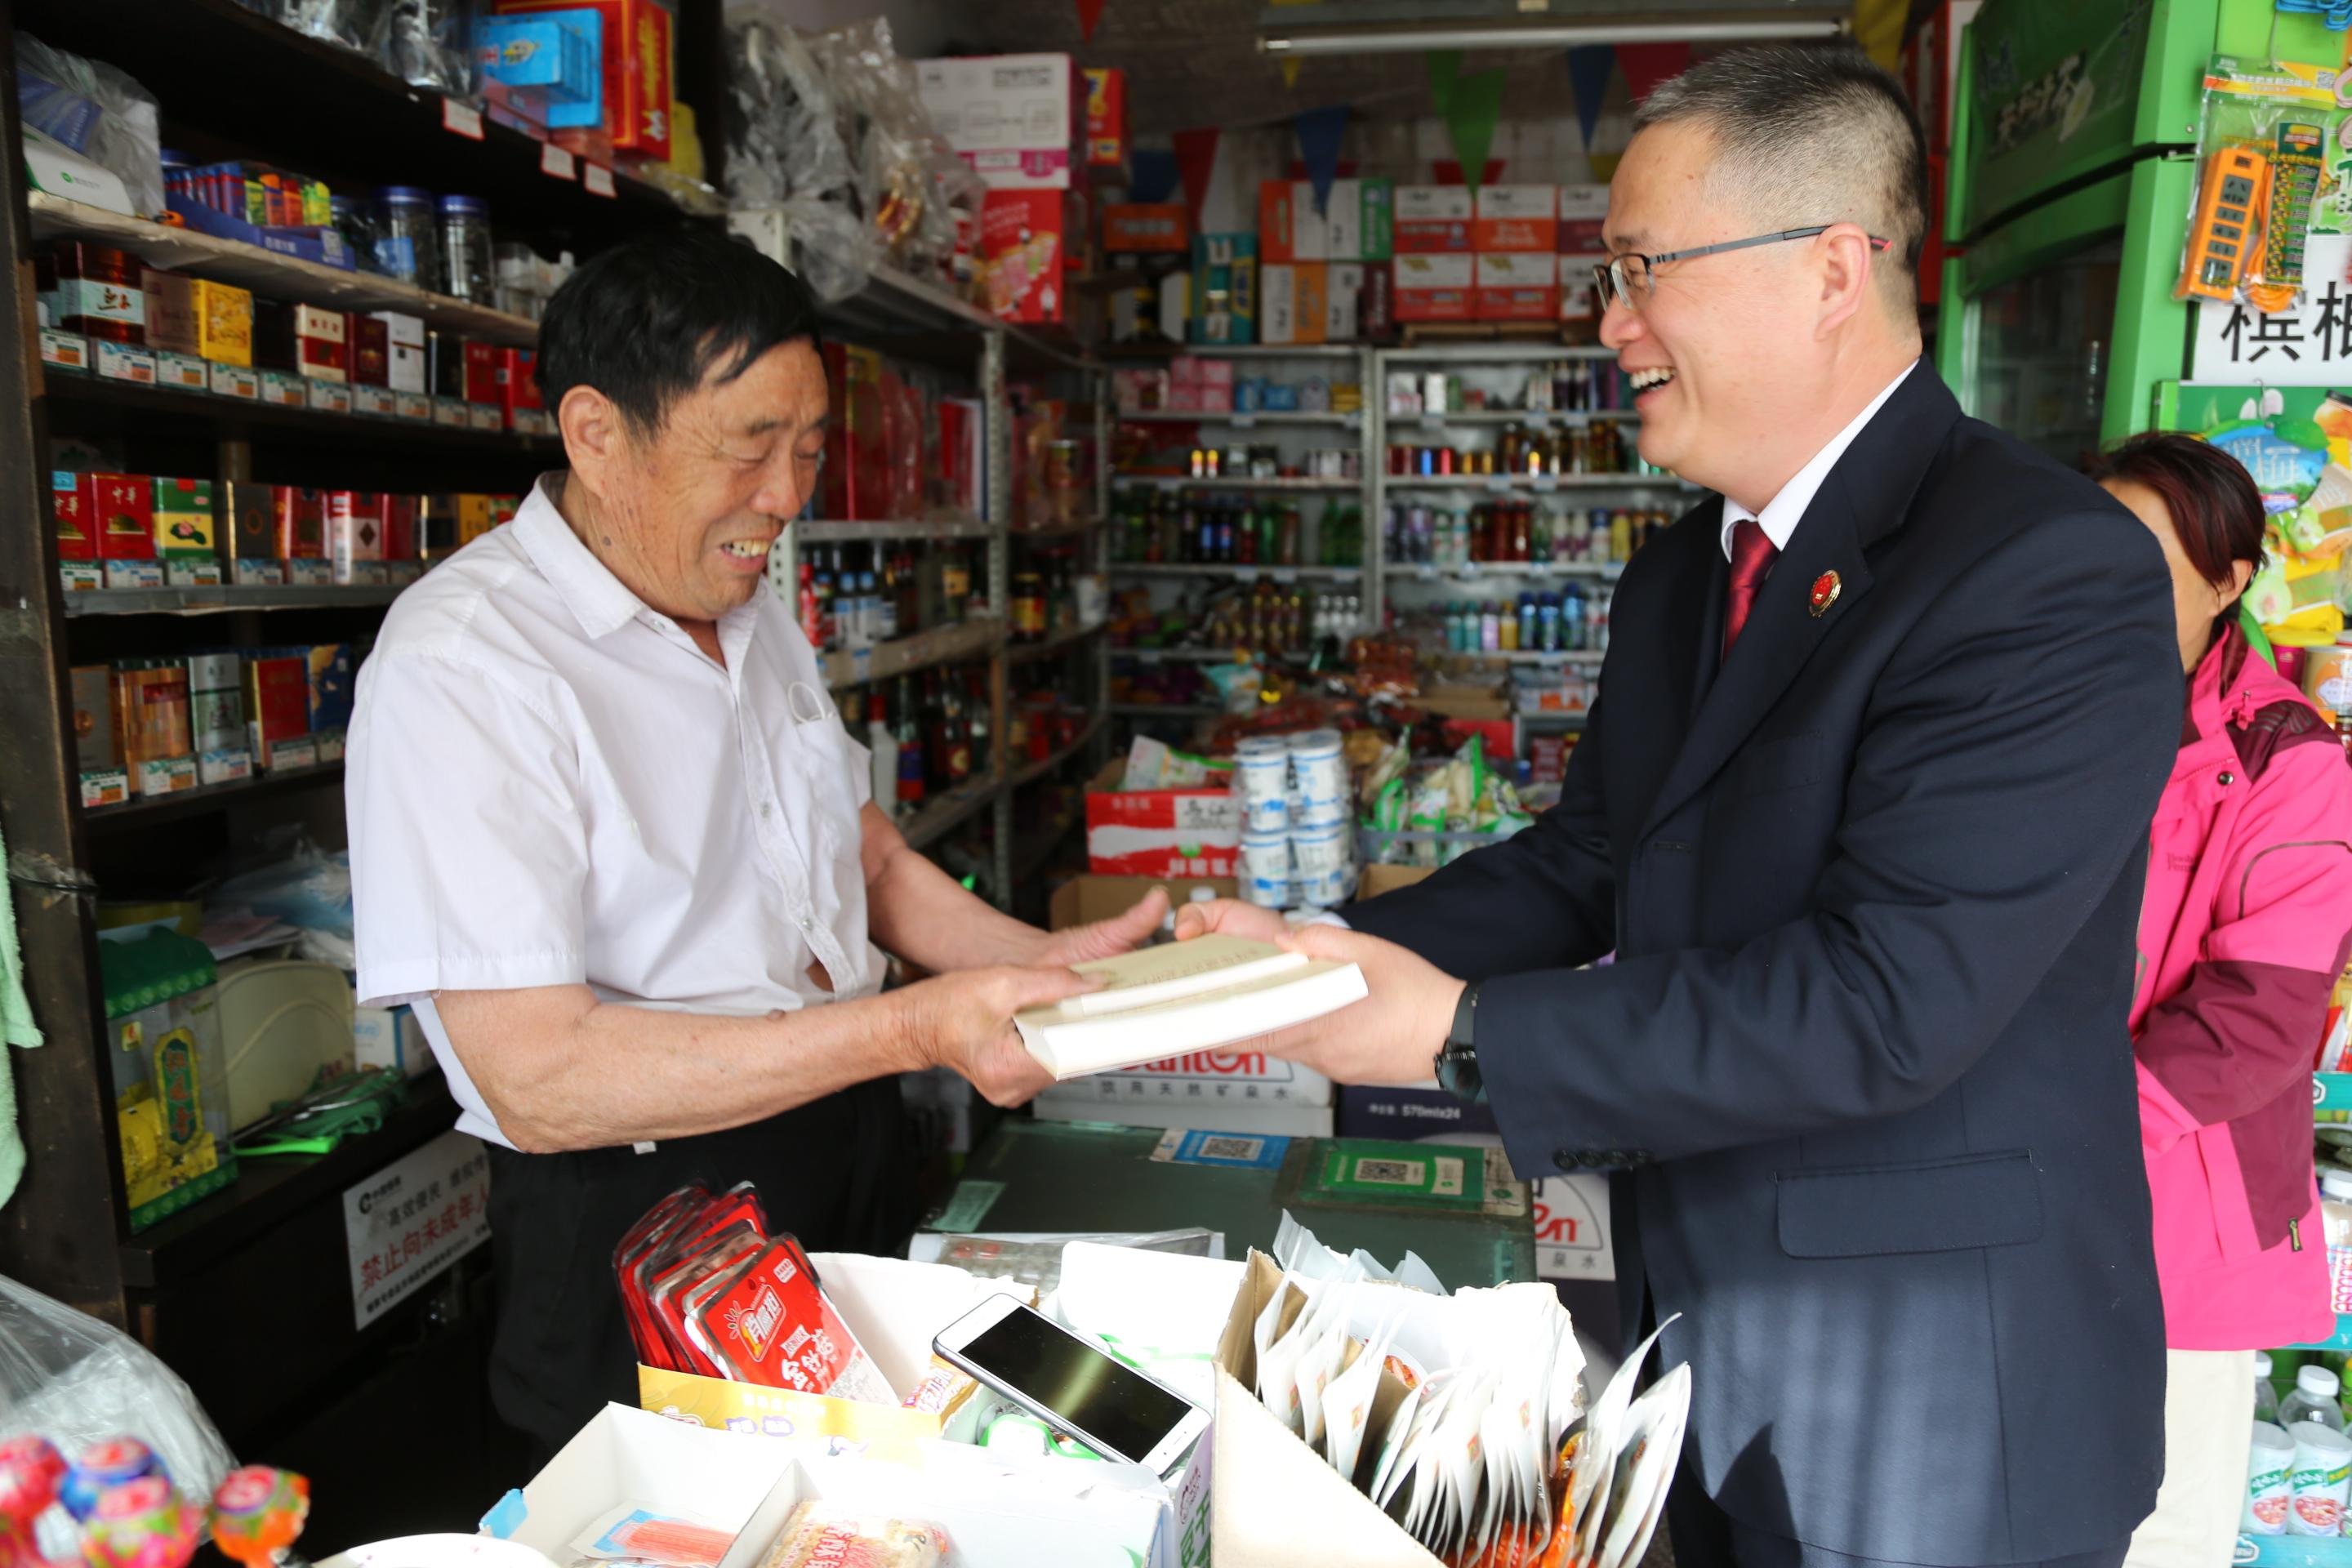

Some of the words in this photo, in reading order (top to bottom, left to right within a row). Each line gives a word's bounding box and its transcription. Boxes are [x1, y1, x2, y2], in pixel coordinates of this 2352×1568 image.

[1101, 1078, 1289, 1101] 饮用天然矿泉水
